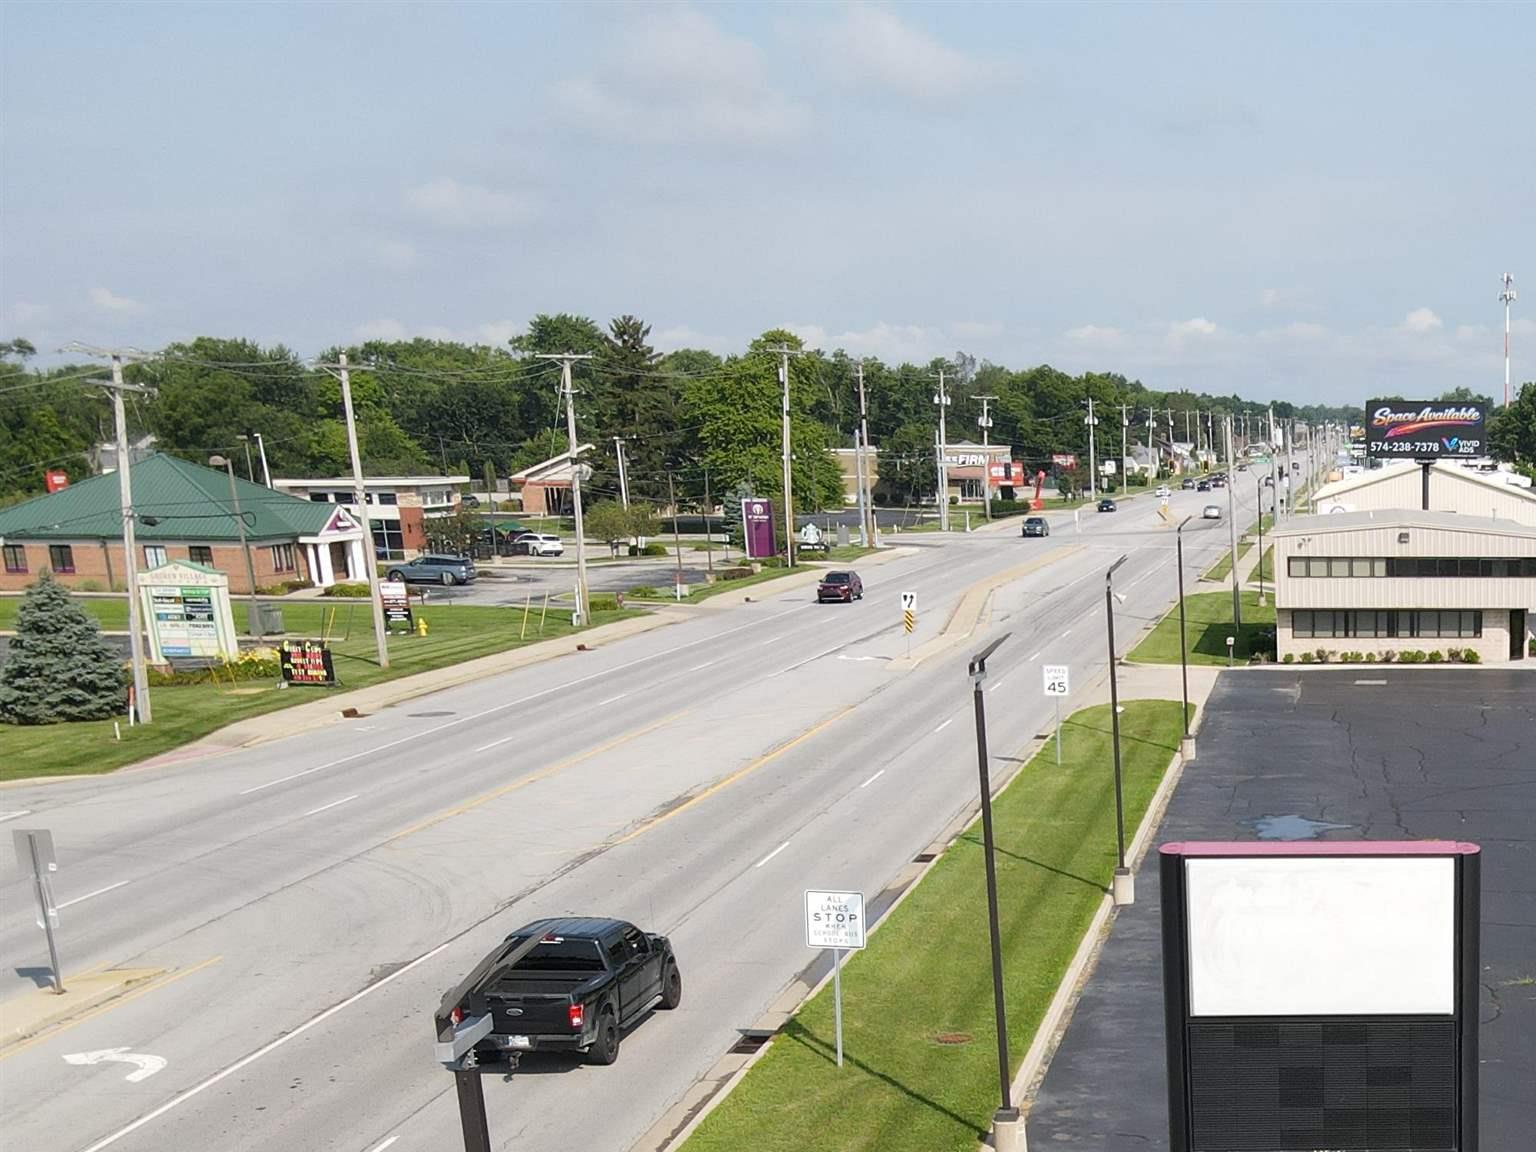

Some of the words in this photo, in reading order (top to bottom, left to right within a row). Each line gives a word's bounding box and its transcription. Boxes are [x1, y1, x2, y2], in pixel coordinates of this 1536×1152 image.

[1372, 407, 1416, 426] Space
[1415, 407, 1481, 422] Available
[1370, 442, 1439, 452] 574-238-7378
[1048, 682, 1066, 693] 45
[821, 904, 848, 912] LANES
[814, 913, 857, 922] STOP
